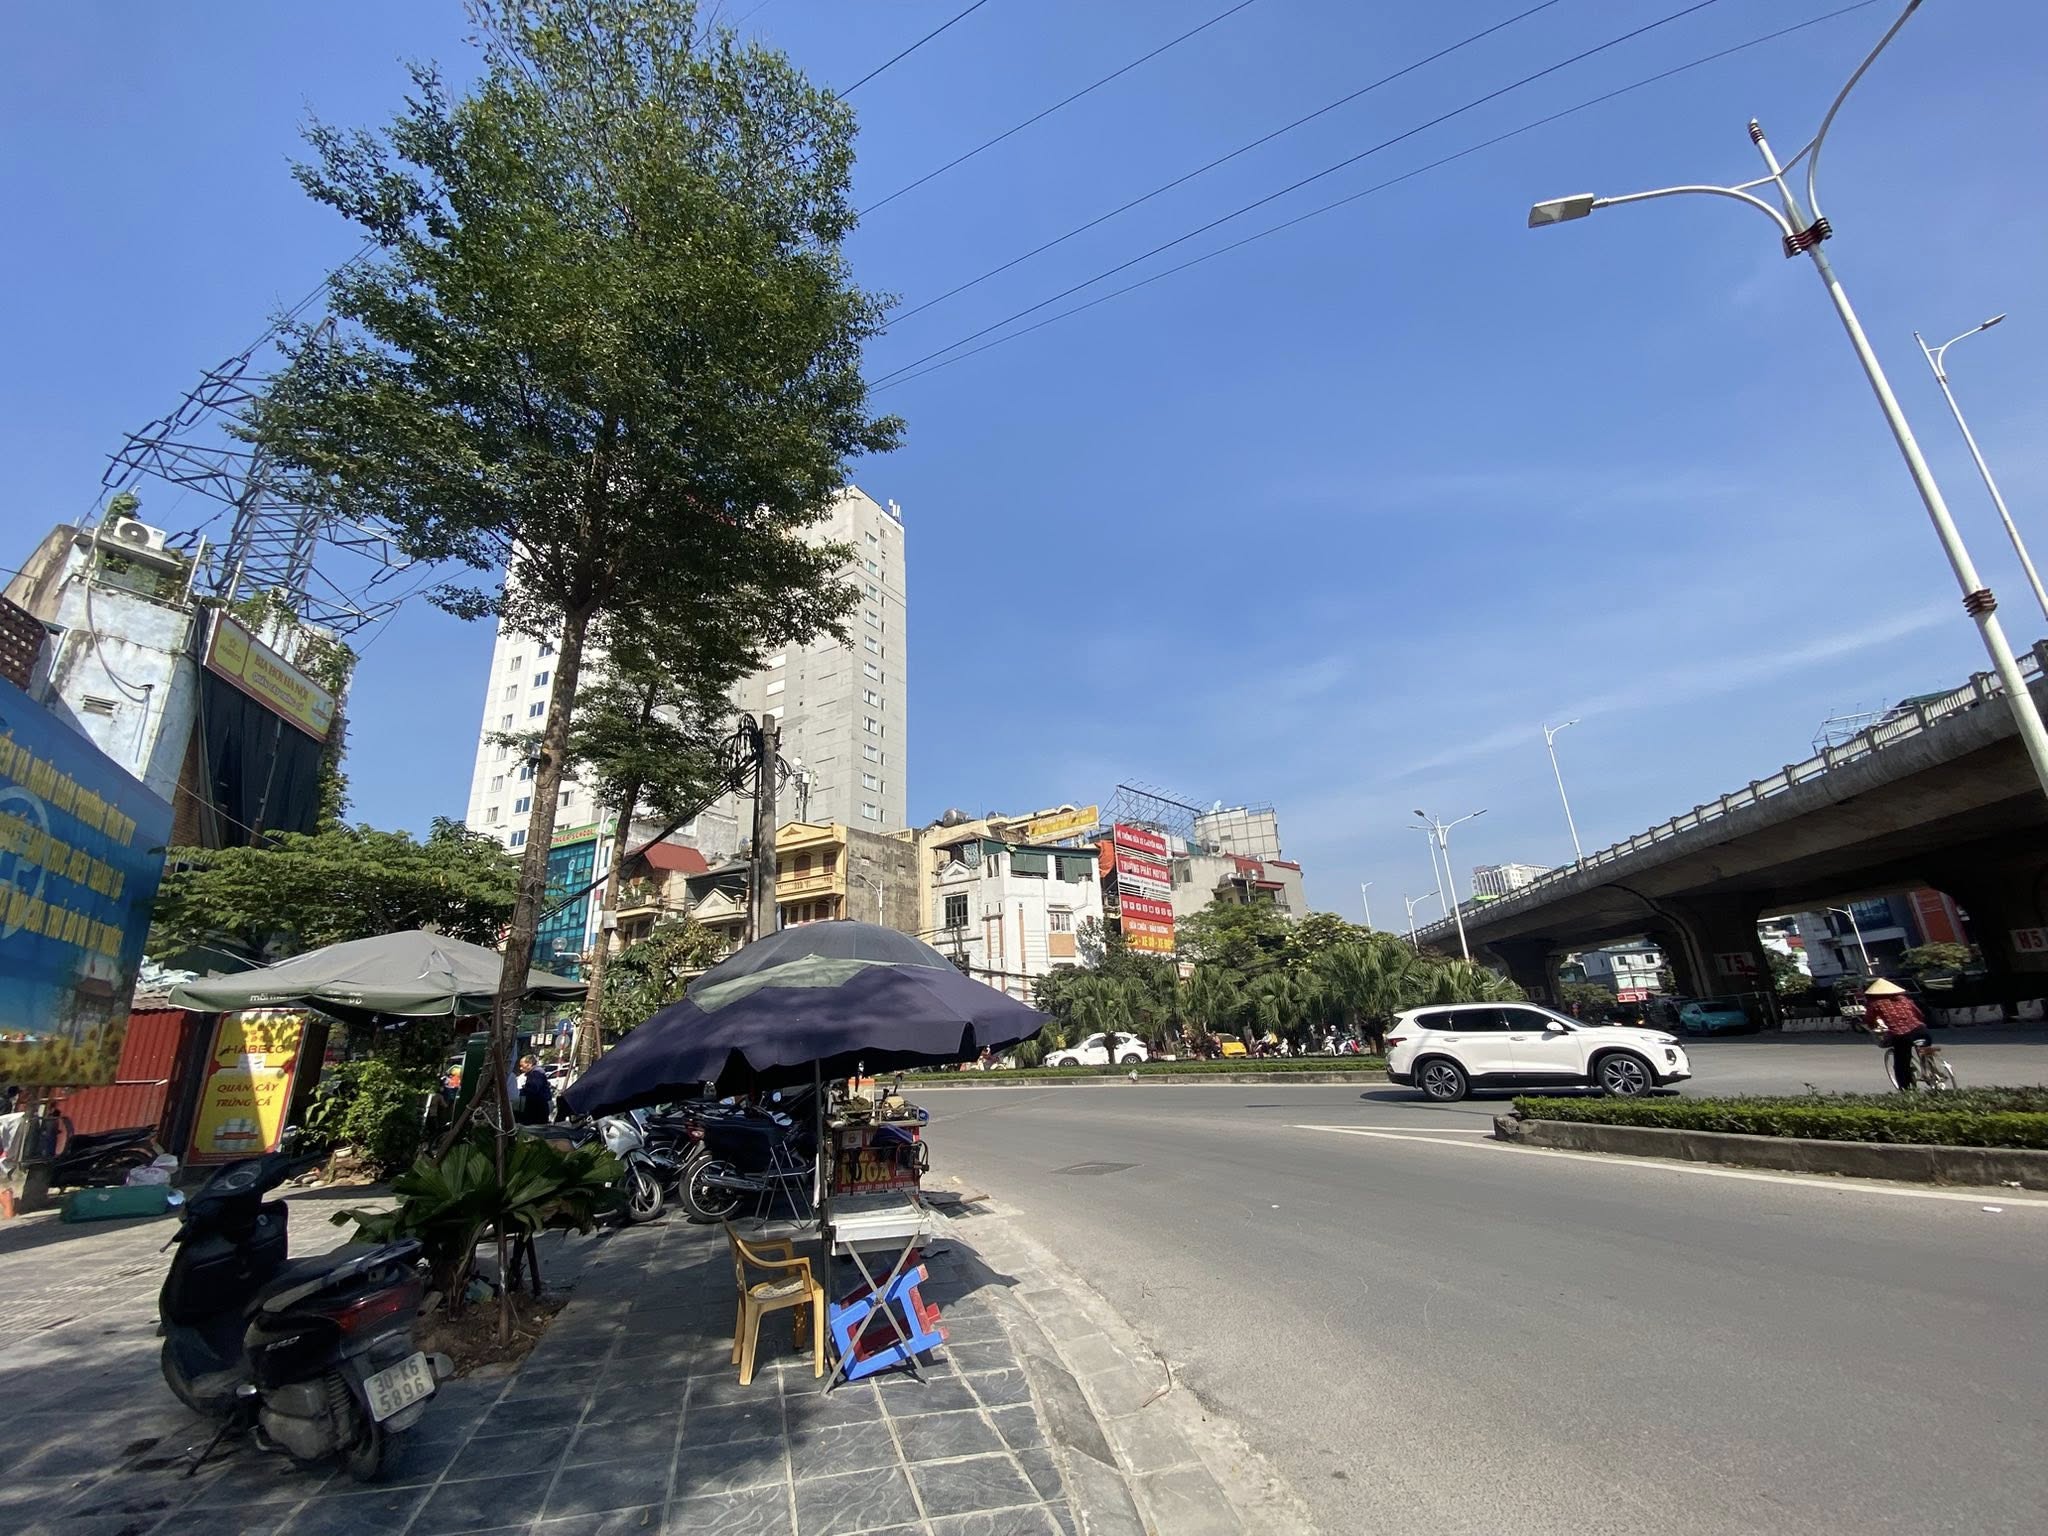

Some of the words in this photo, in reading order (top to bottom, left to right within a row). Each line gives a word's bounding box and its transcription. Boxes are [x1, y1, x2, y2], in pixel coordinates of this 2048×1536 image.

[218, 1045, 285, 1056] HABECO
[217, 1082, 252, 1093] QUÁN
[255, 1082, 279, 1092] CÂY
[256, 1096, 272, 1106] CÁ
[380, 1377, 425, 1412] 5896
